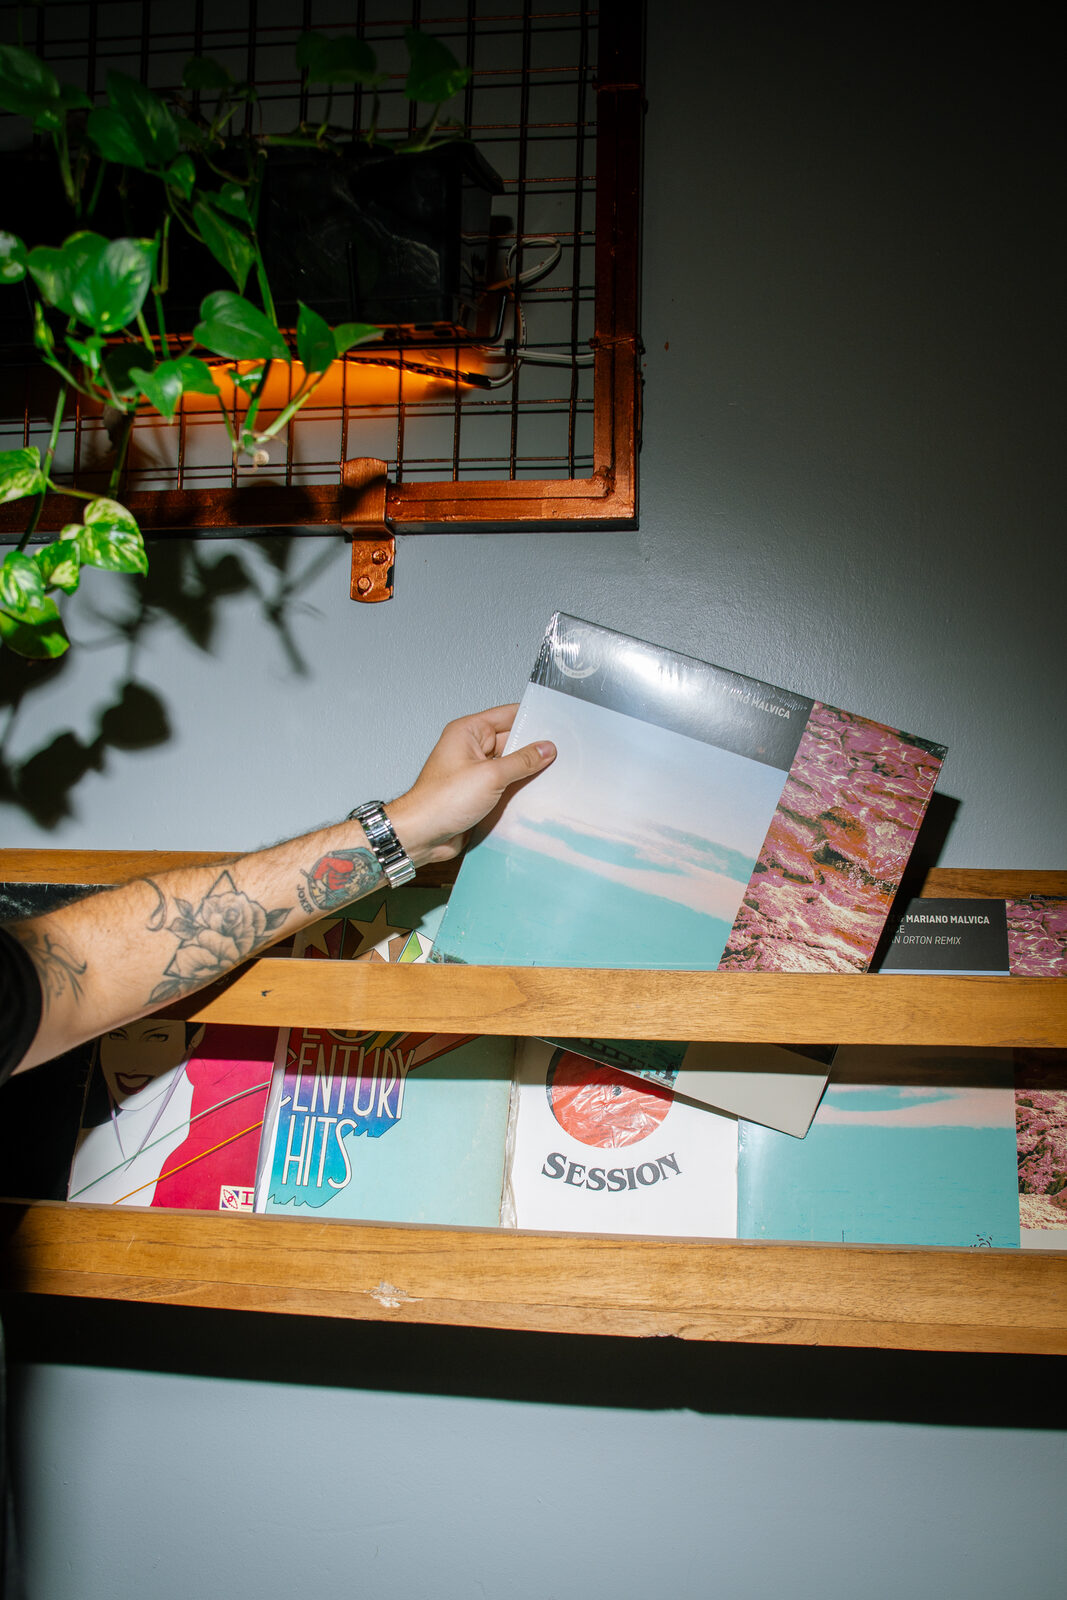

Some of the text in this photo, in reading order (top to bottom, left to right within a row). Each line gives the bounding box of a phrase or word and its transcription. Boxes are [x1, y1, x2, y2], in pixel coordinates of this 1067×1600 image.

[906, 914, 990, 924] MARIANO MALVICA
[902, 936, 933, 945] ORTON
[934, 936, 962, 945] REMIX
[281, 1114, 357, 1189] HITS
[541, 1152, 683, 1193] SESSION
